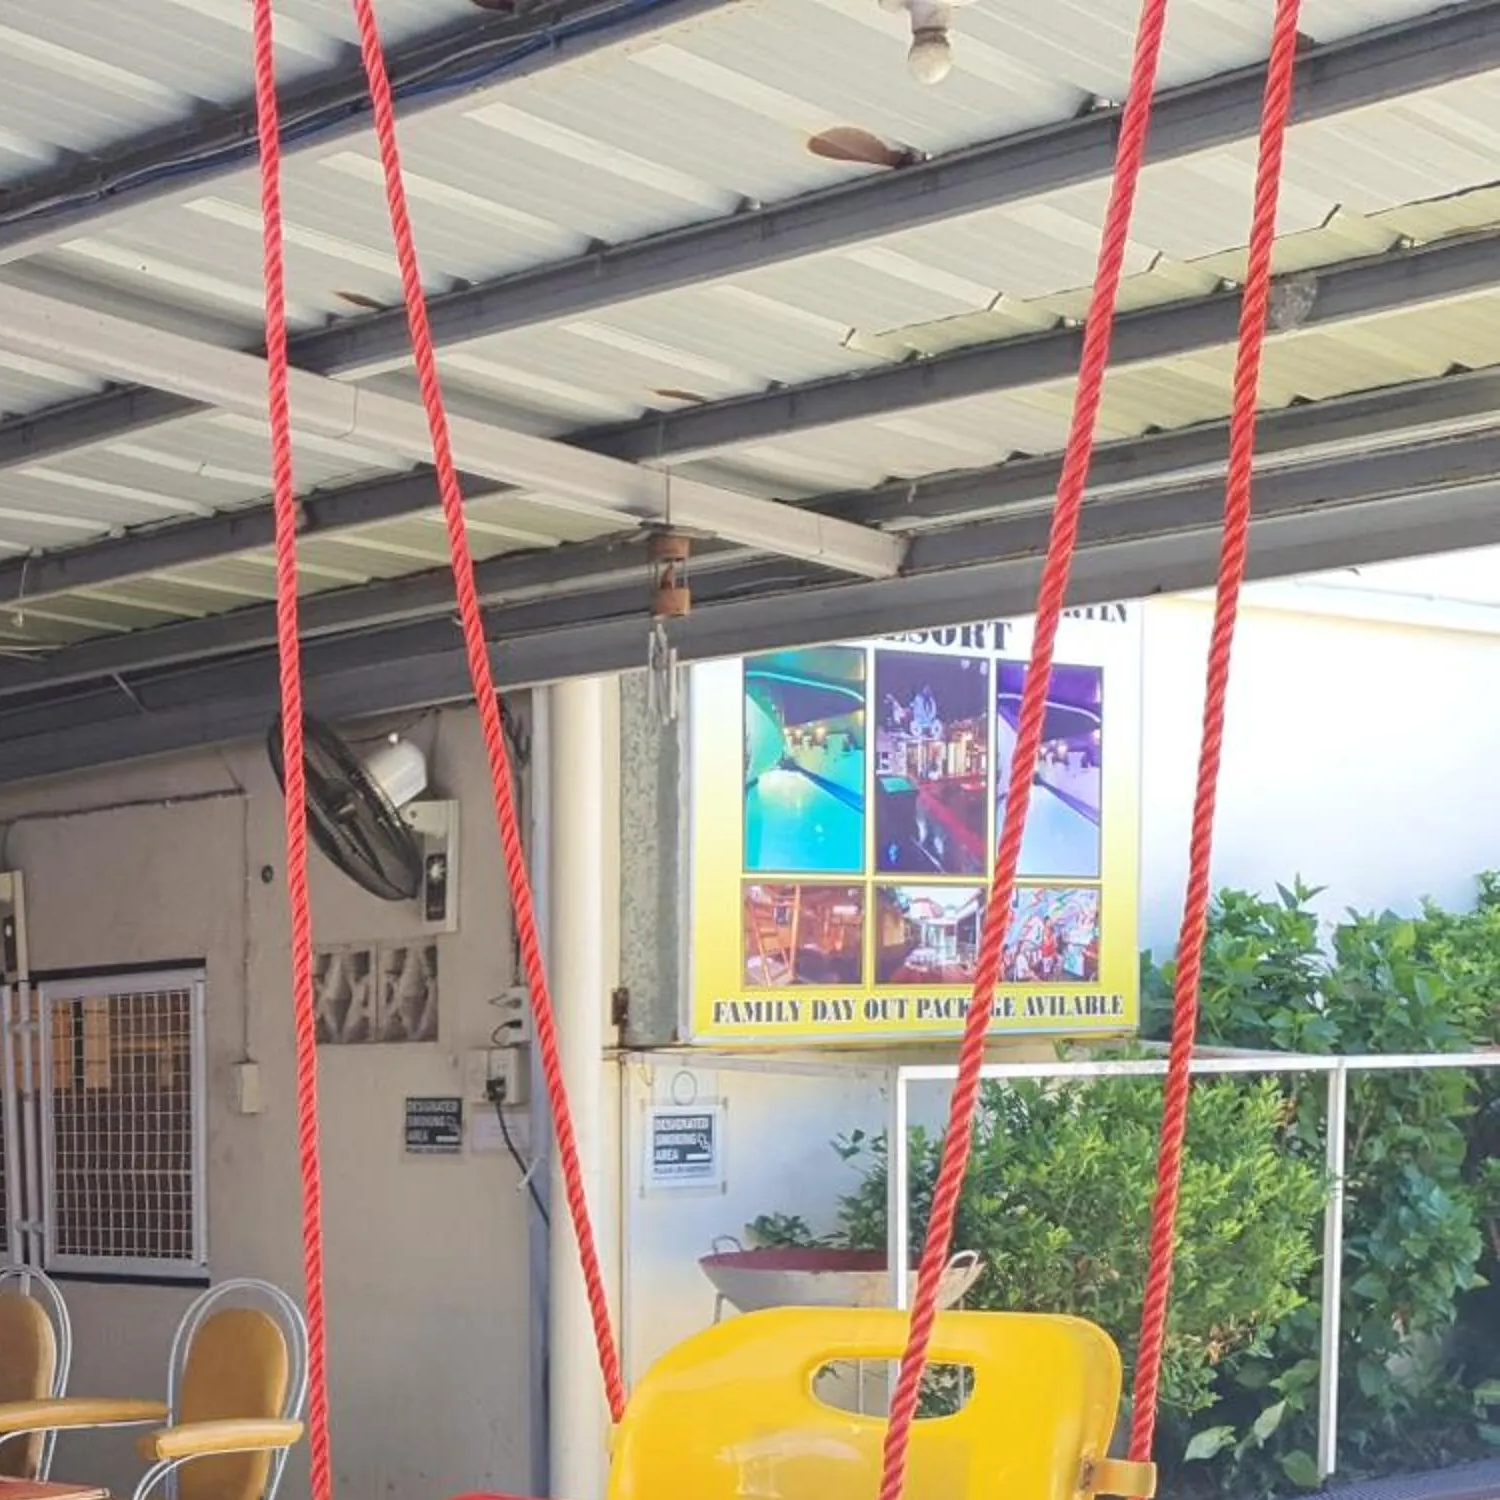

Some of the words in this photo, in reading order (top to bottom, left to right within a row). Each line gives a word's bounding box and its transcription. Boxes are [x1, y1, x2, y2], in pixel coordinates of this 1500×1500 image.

[713, 1000, 800, 1023] FAMILY
[812, 998, 855, 1021] DAY
[864, 998, 909, 1020] OUT
[916, 997, 1015, 1018] PACKGE
[1023, 995, 1124, 1017] AVILABLE
